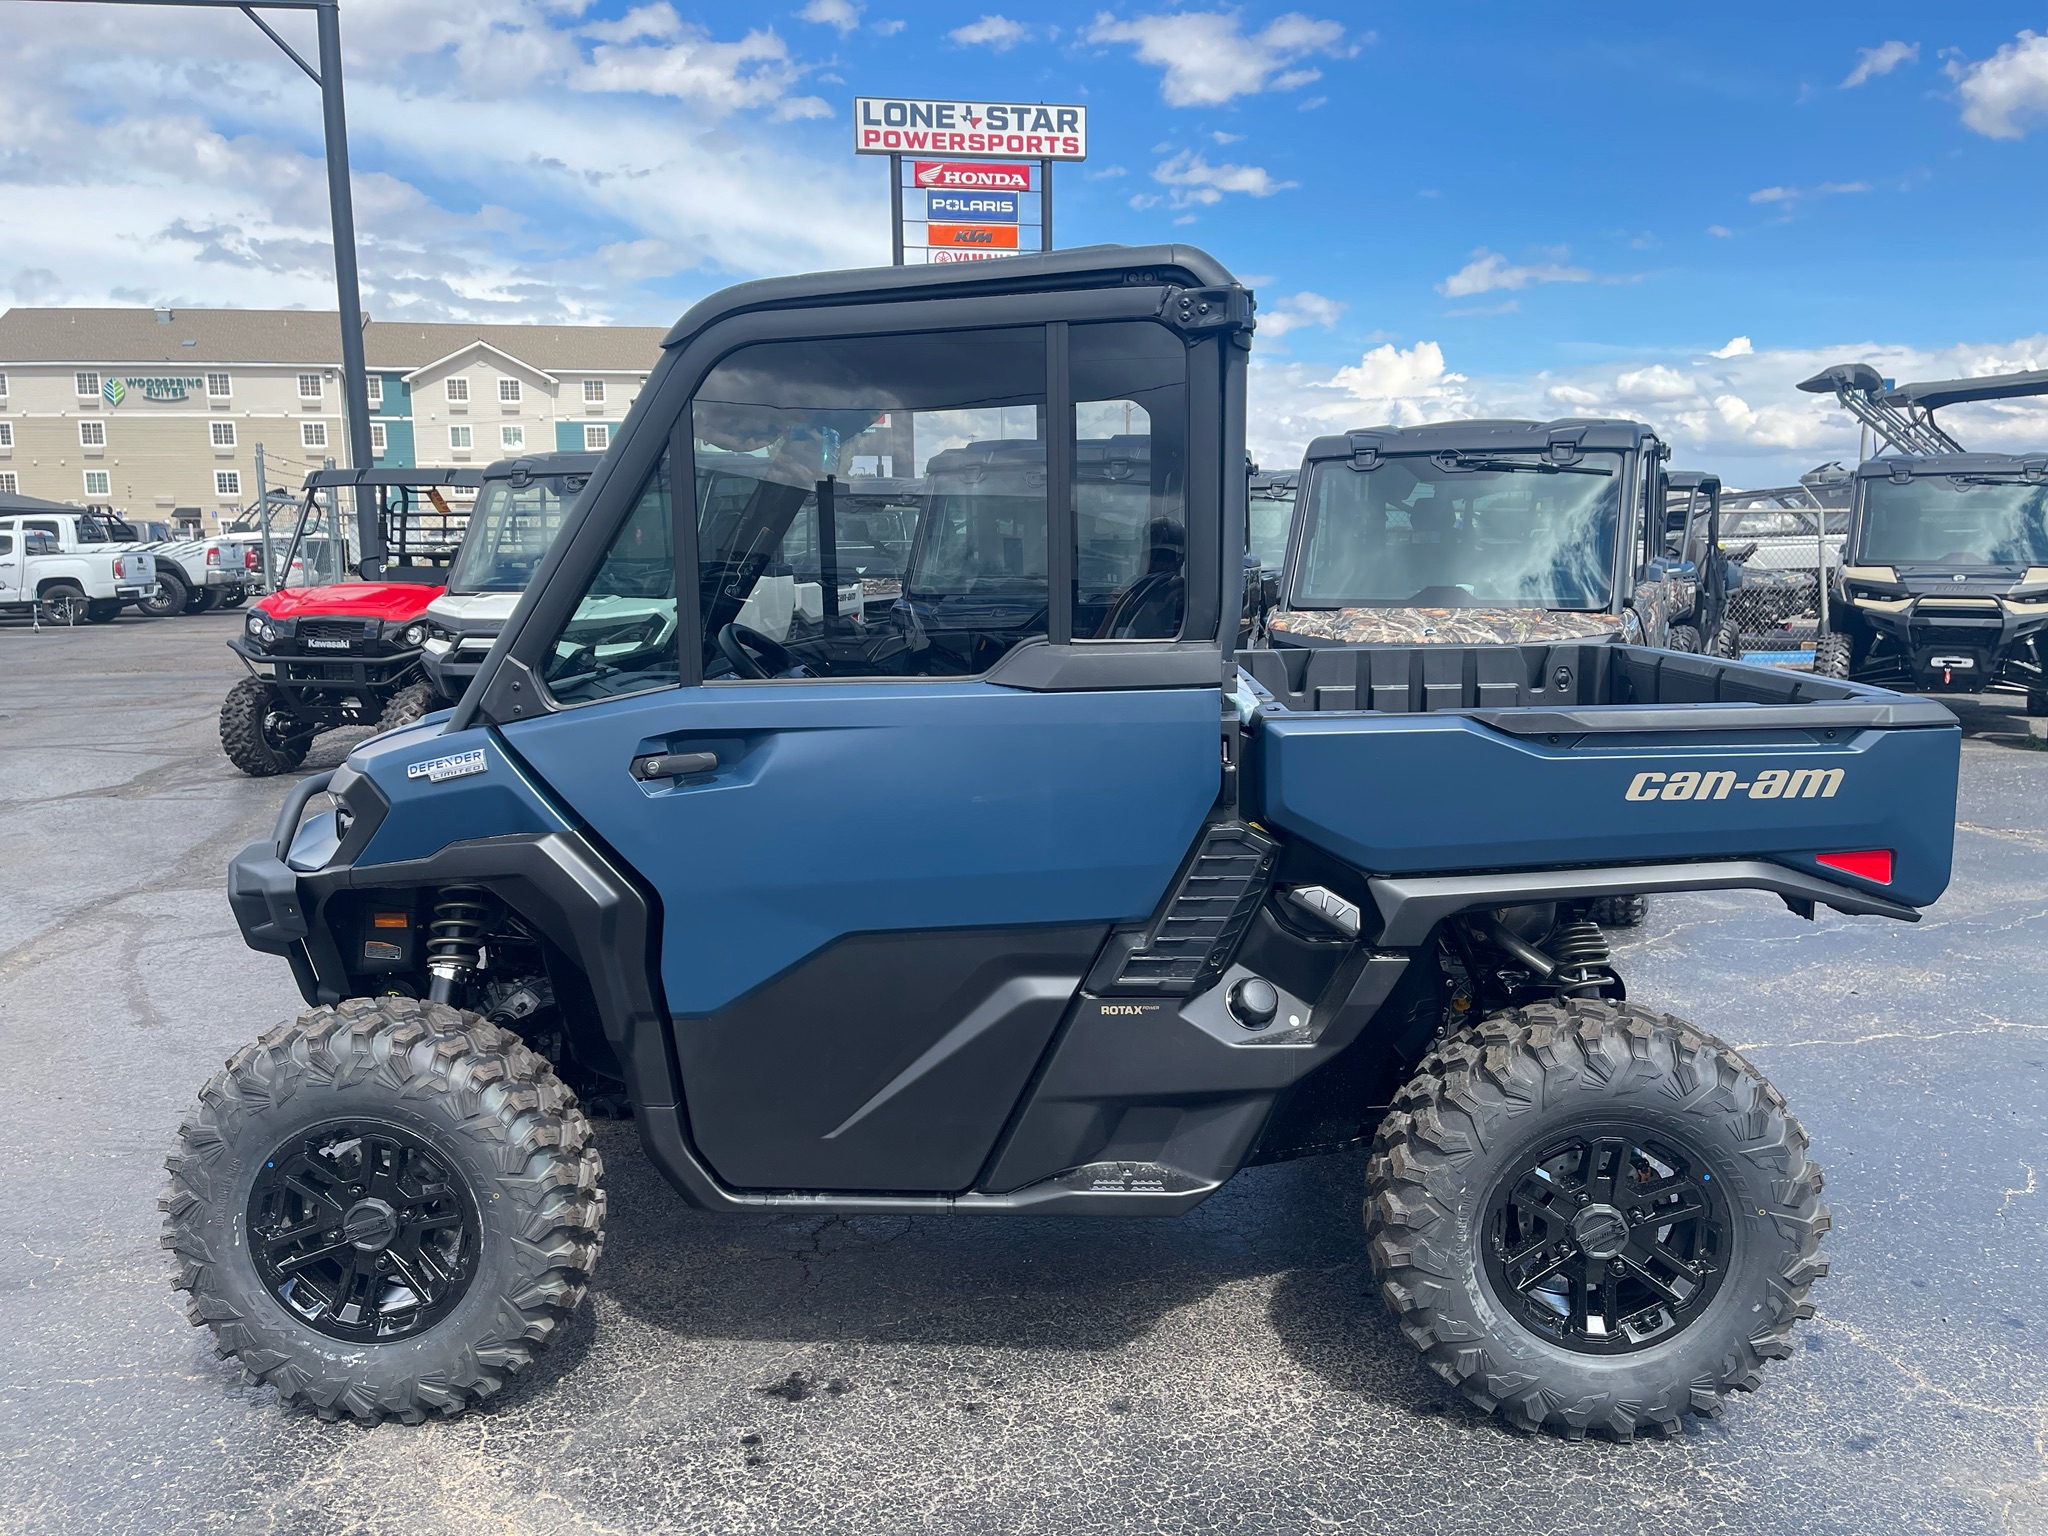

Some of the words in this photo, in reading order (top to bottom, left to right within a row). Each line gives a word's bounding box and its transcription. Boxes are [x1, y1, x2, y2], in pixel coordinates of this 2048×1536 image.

[863, 101, 956, 129] LONE
[986, 106, 1079, 133] STAR
[864, 129, 1079, 153] POWERSPORTS
[943, 171, 1027, 186] HONDA
[932, 199, 1014, 212] POLARIS
[954, 230, 993, 243] KTM
[125, 377, 204, 389] WOODSPRING
[145, 387, 186, 398] SUITES
[308, 639, 350, 649] Kawasaki
[410, 751, 482, 775] DEFENDER
[432, 764, 481, 780] LIMITED
[1625, 768, 1845, 801] can-am
[1100, 1005, 1143, 1015] ROTAX
